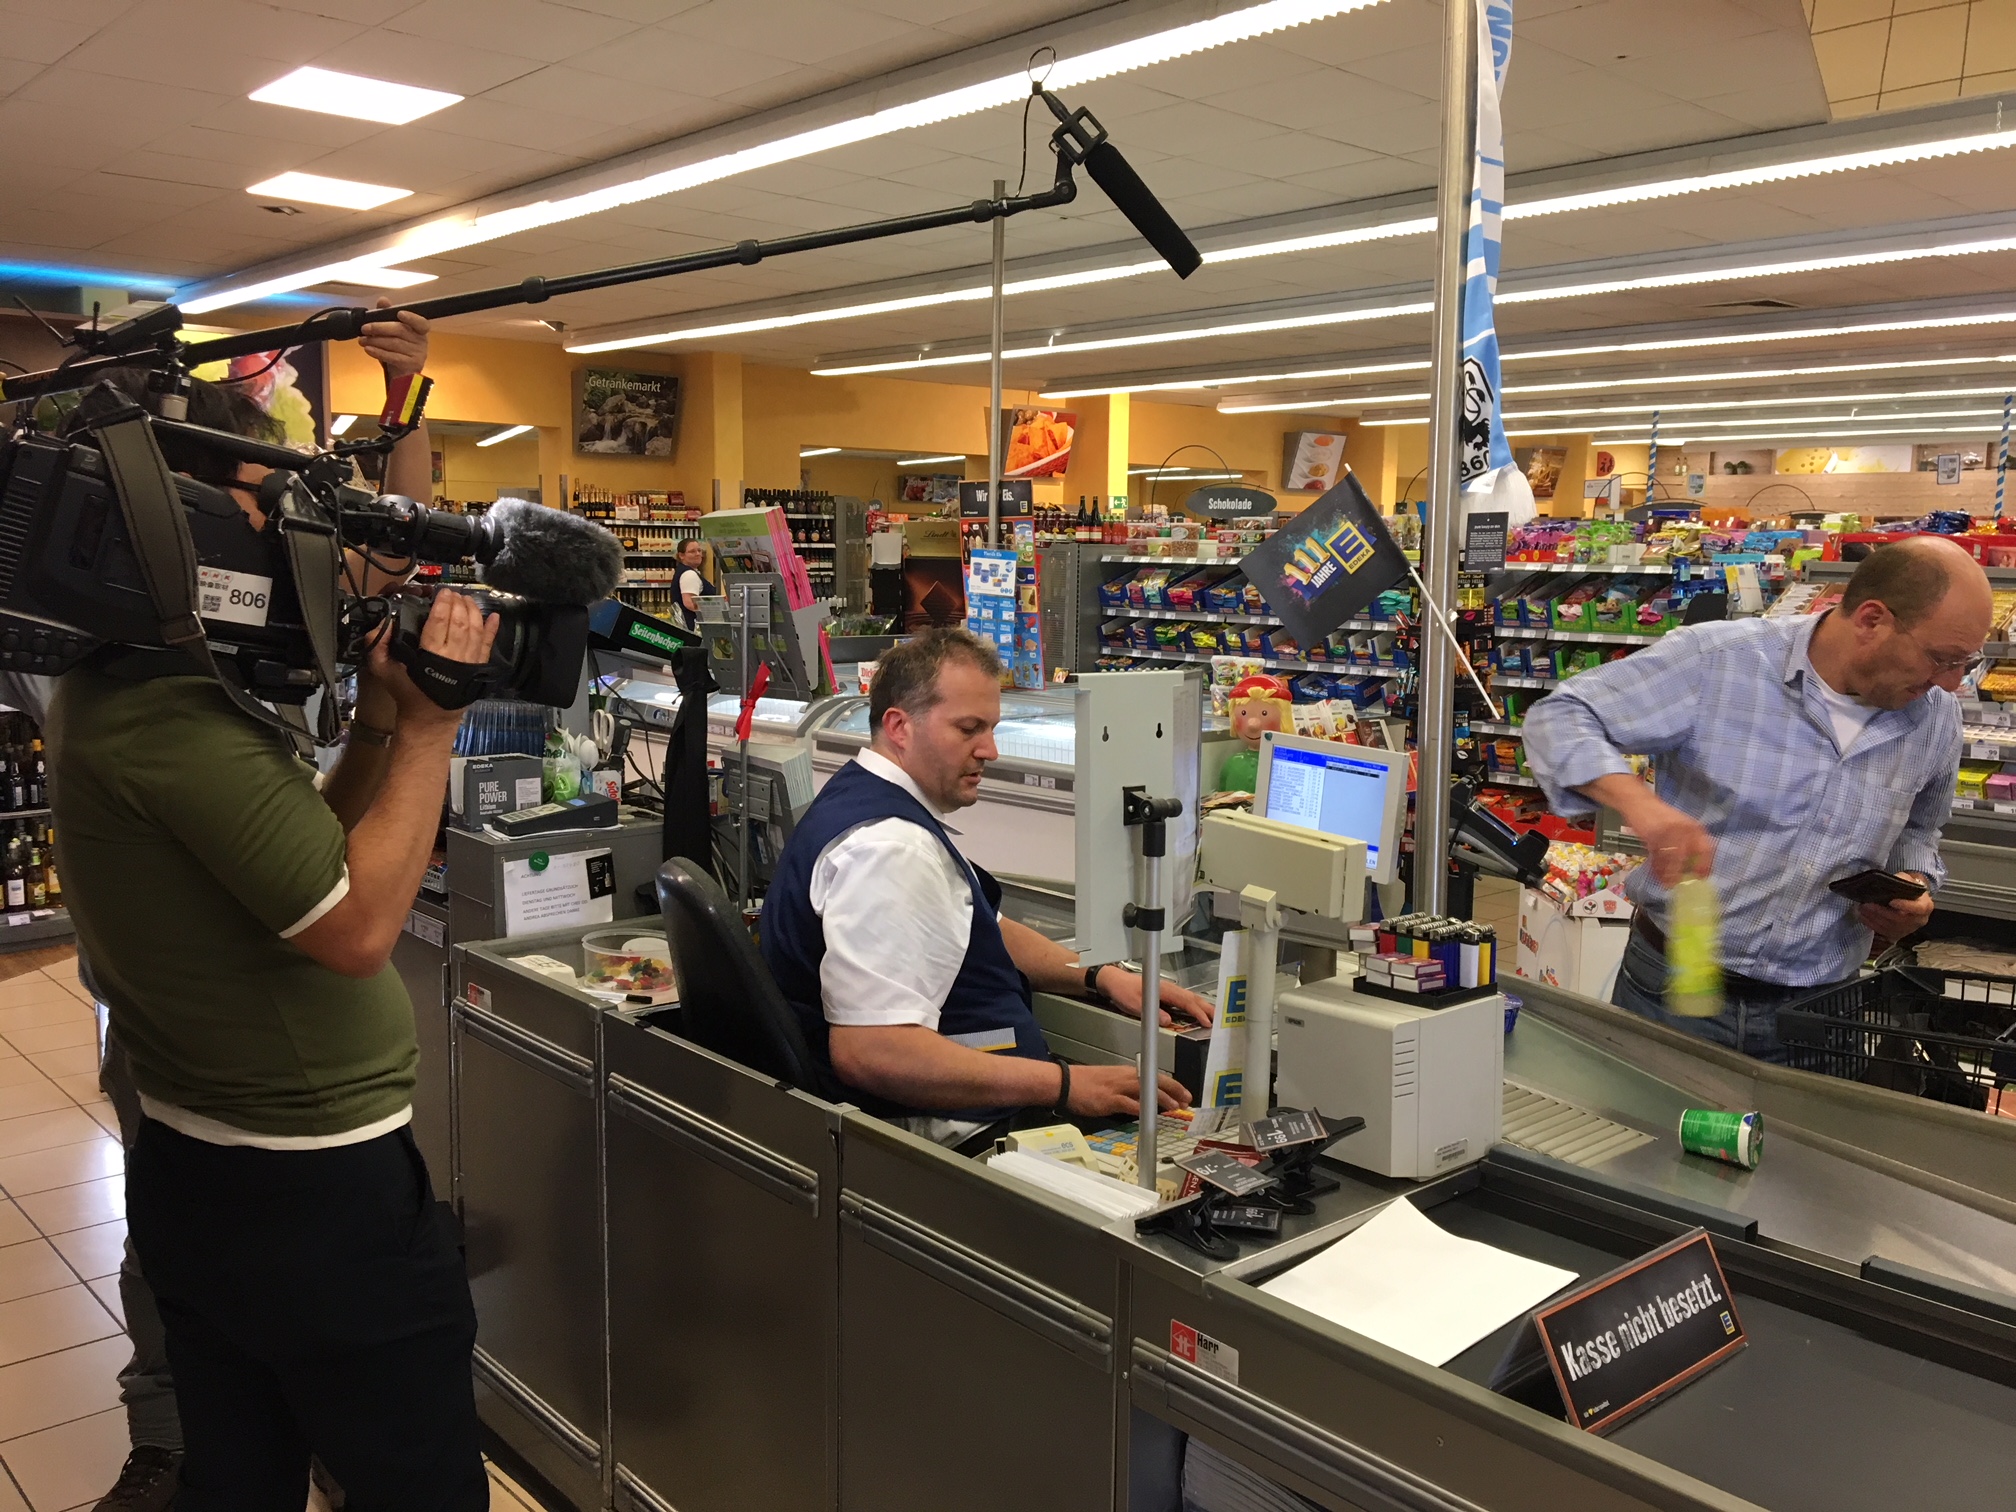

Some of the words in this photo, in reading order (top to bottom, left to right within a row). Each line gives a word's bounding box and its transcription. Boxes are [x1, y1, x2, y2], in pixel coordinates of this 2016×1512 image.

[975, 489, 988, 502] Wir
[1002, 489, 1014, 501] Eis.
[1208, 498, 1252, 511] Schokolade
[923, 530, 949, 539] Lindt
[1330, 527, 1365, 564] E
[1283, 536, 1331, 585] 111
[1348, 548, 1371, 570] EDEKA
[200, 570, 231, 581] NHK
[1310, 560, 1338, 589] JAHRE
[229, 589, 267, 609] 806
[631, 623, 681, 650] Seitenbacher
[424, 666, 458, 686] Canon
[479, 780, 499, 793] PURE
[479, 791, 507, 803] POWER
[1560, 1330, 1621, 1382] Kasse
[1617, 1303, 1664, 1352] nicht
[1656, 1273, 1723, 1330] besetzt.
[1197, 1333, 1219, 1354] Harr
